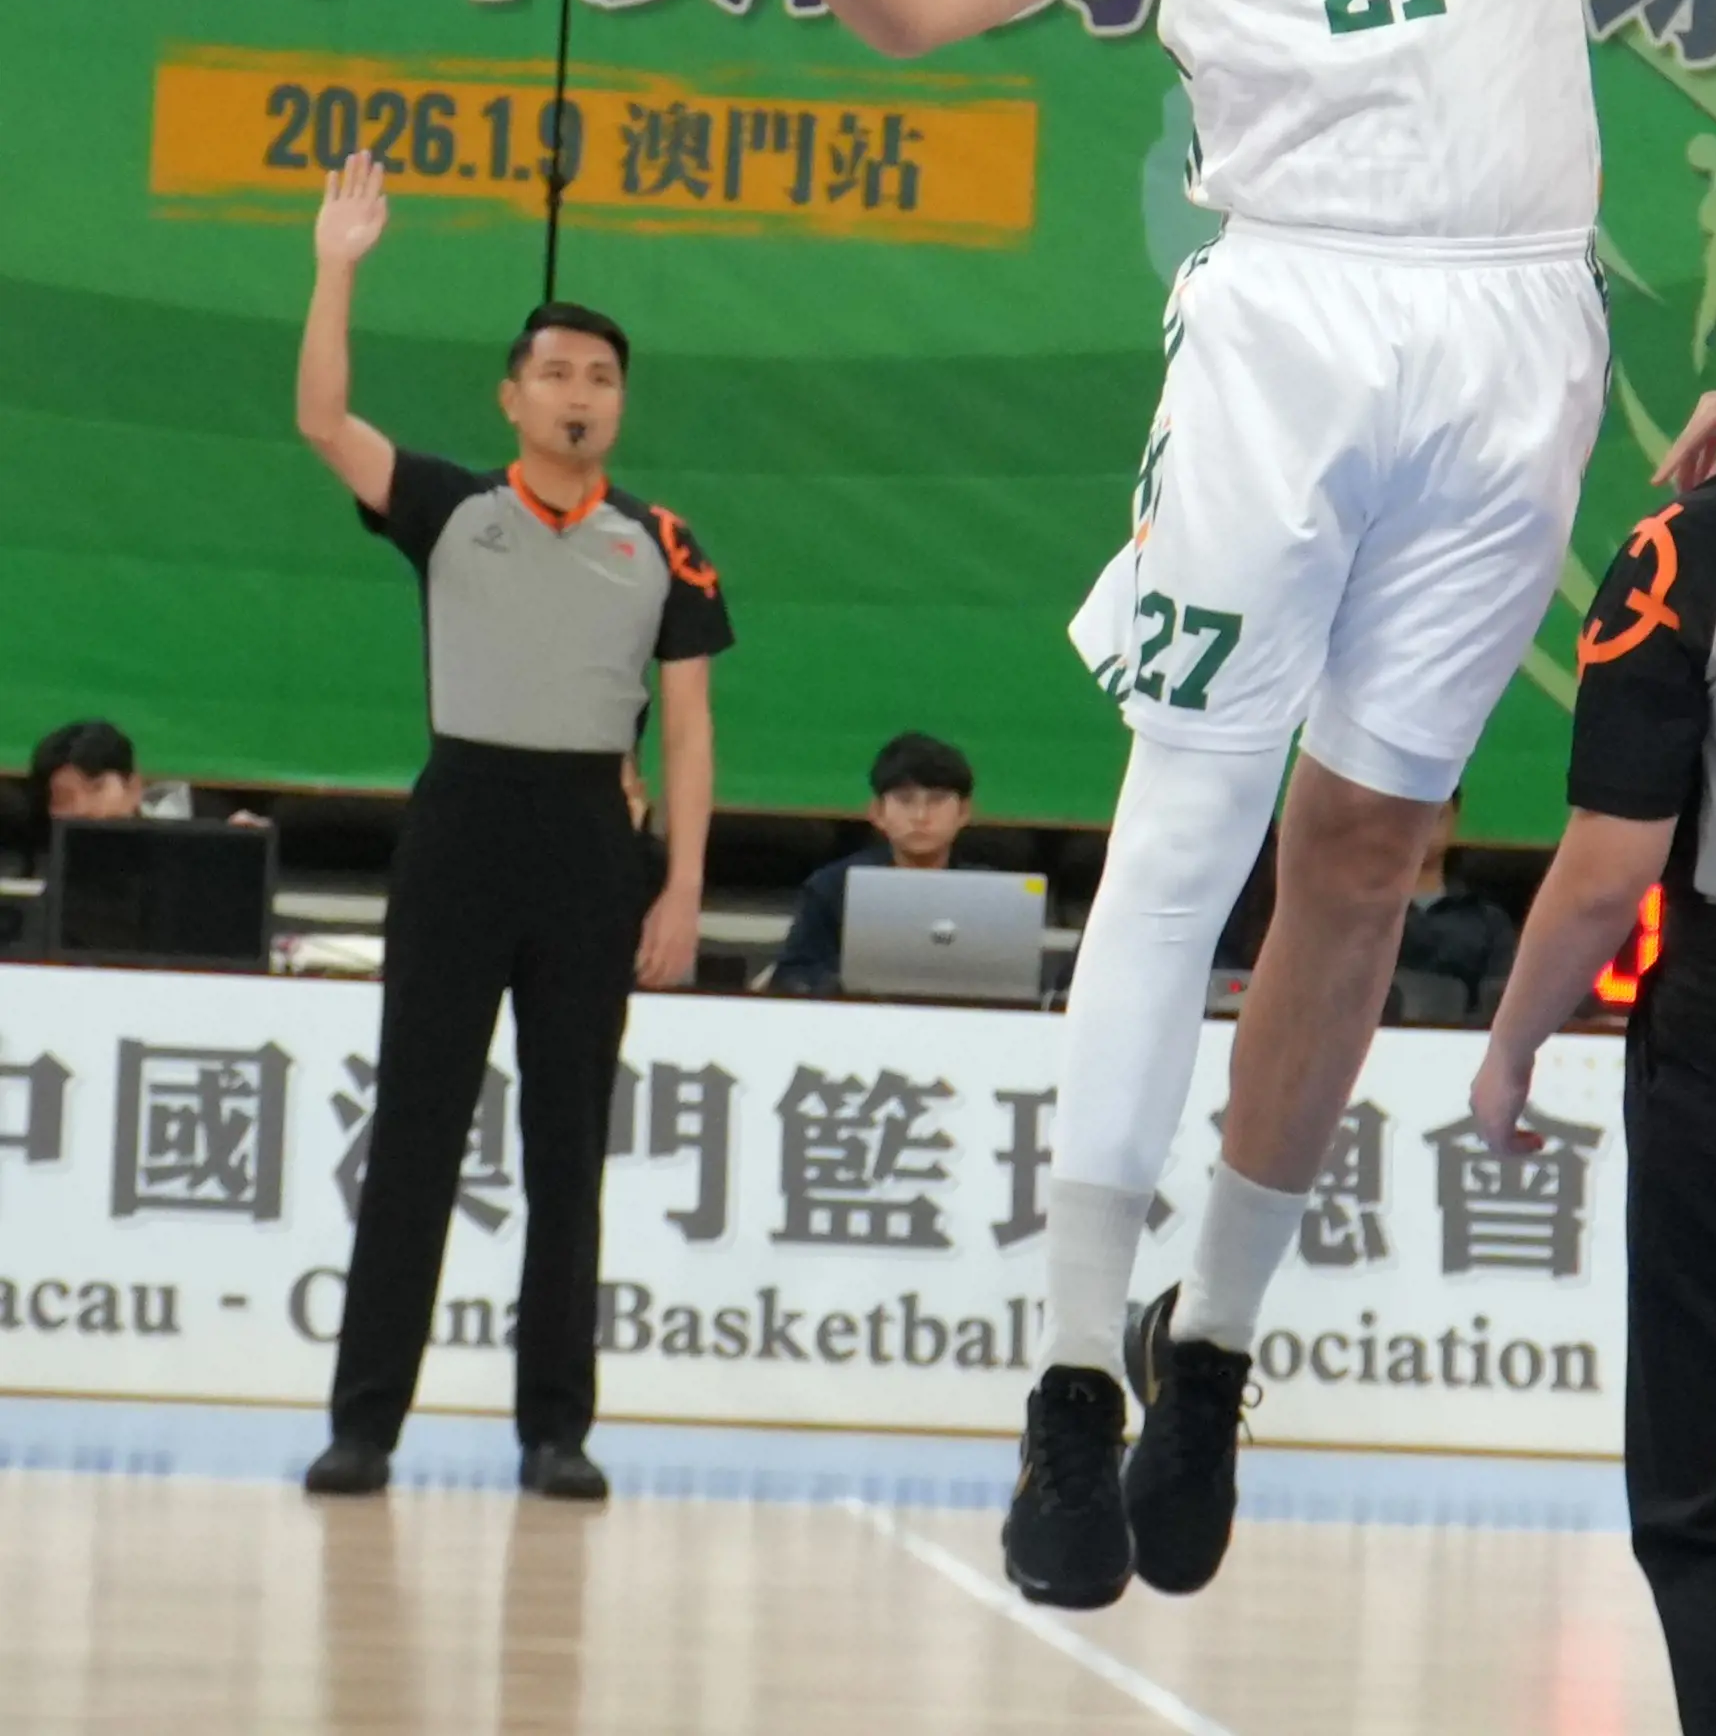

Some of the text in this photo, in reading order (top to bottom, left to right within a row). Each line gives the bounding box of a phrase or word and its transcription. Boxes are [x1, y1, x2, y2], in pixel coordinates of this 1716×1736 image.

[265, 82, 924, 211] 2026.1.9 澳門站
[1134, 590, 1244, 711] 27
[599, 1280, 1046, 1370] Basketbal
